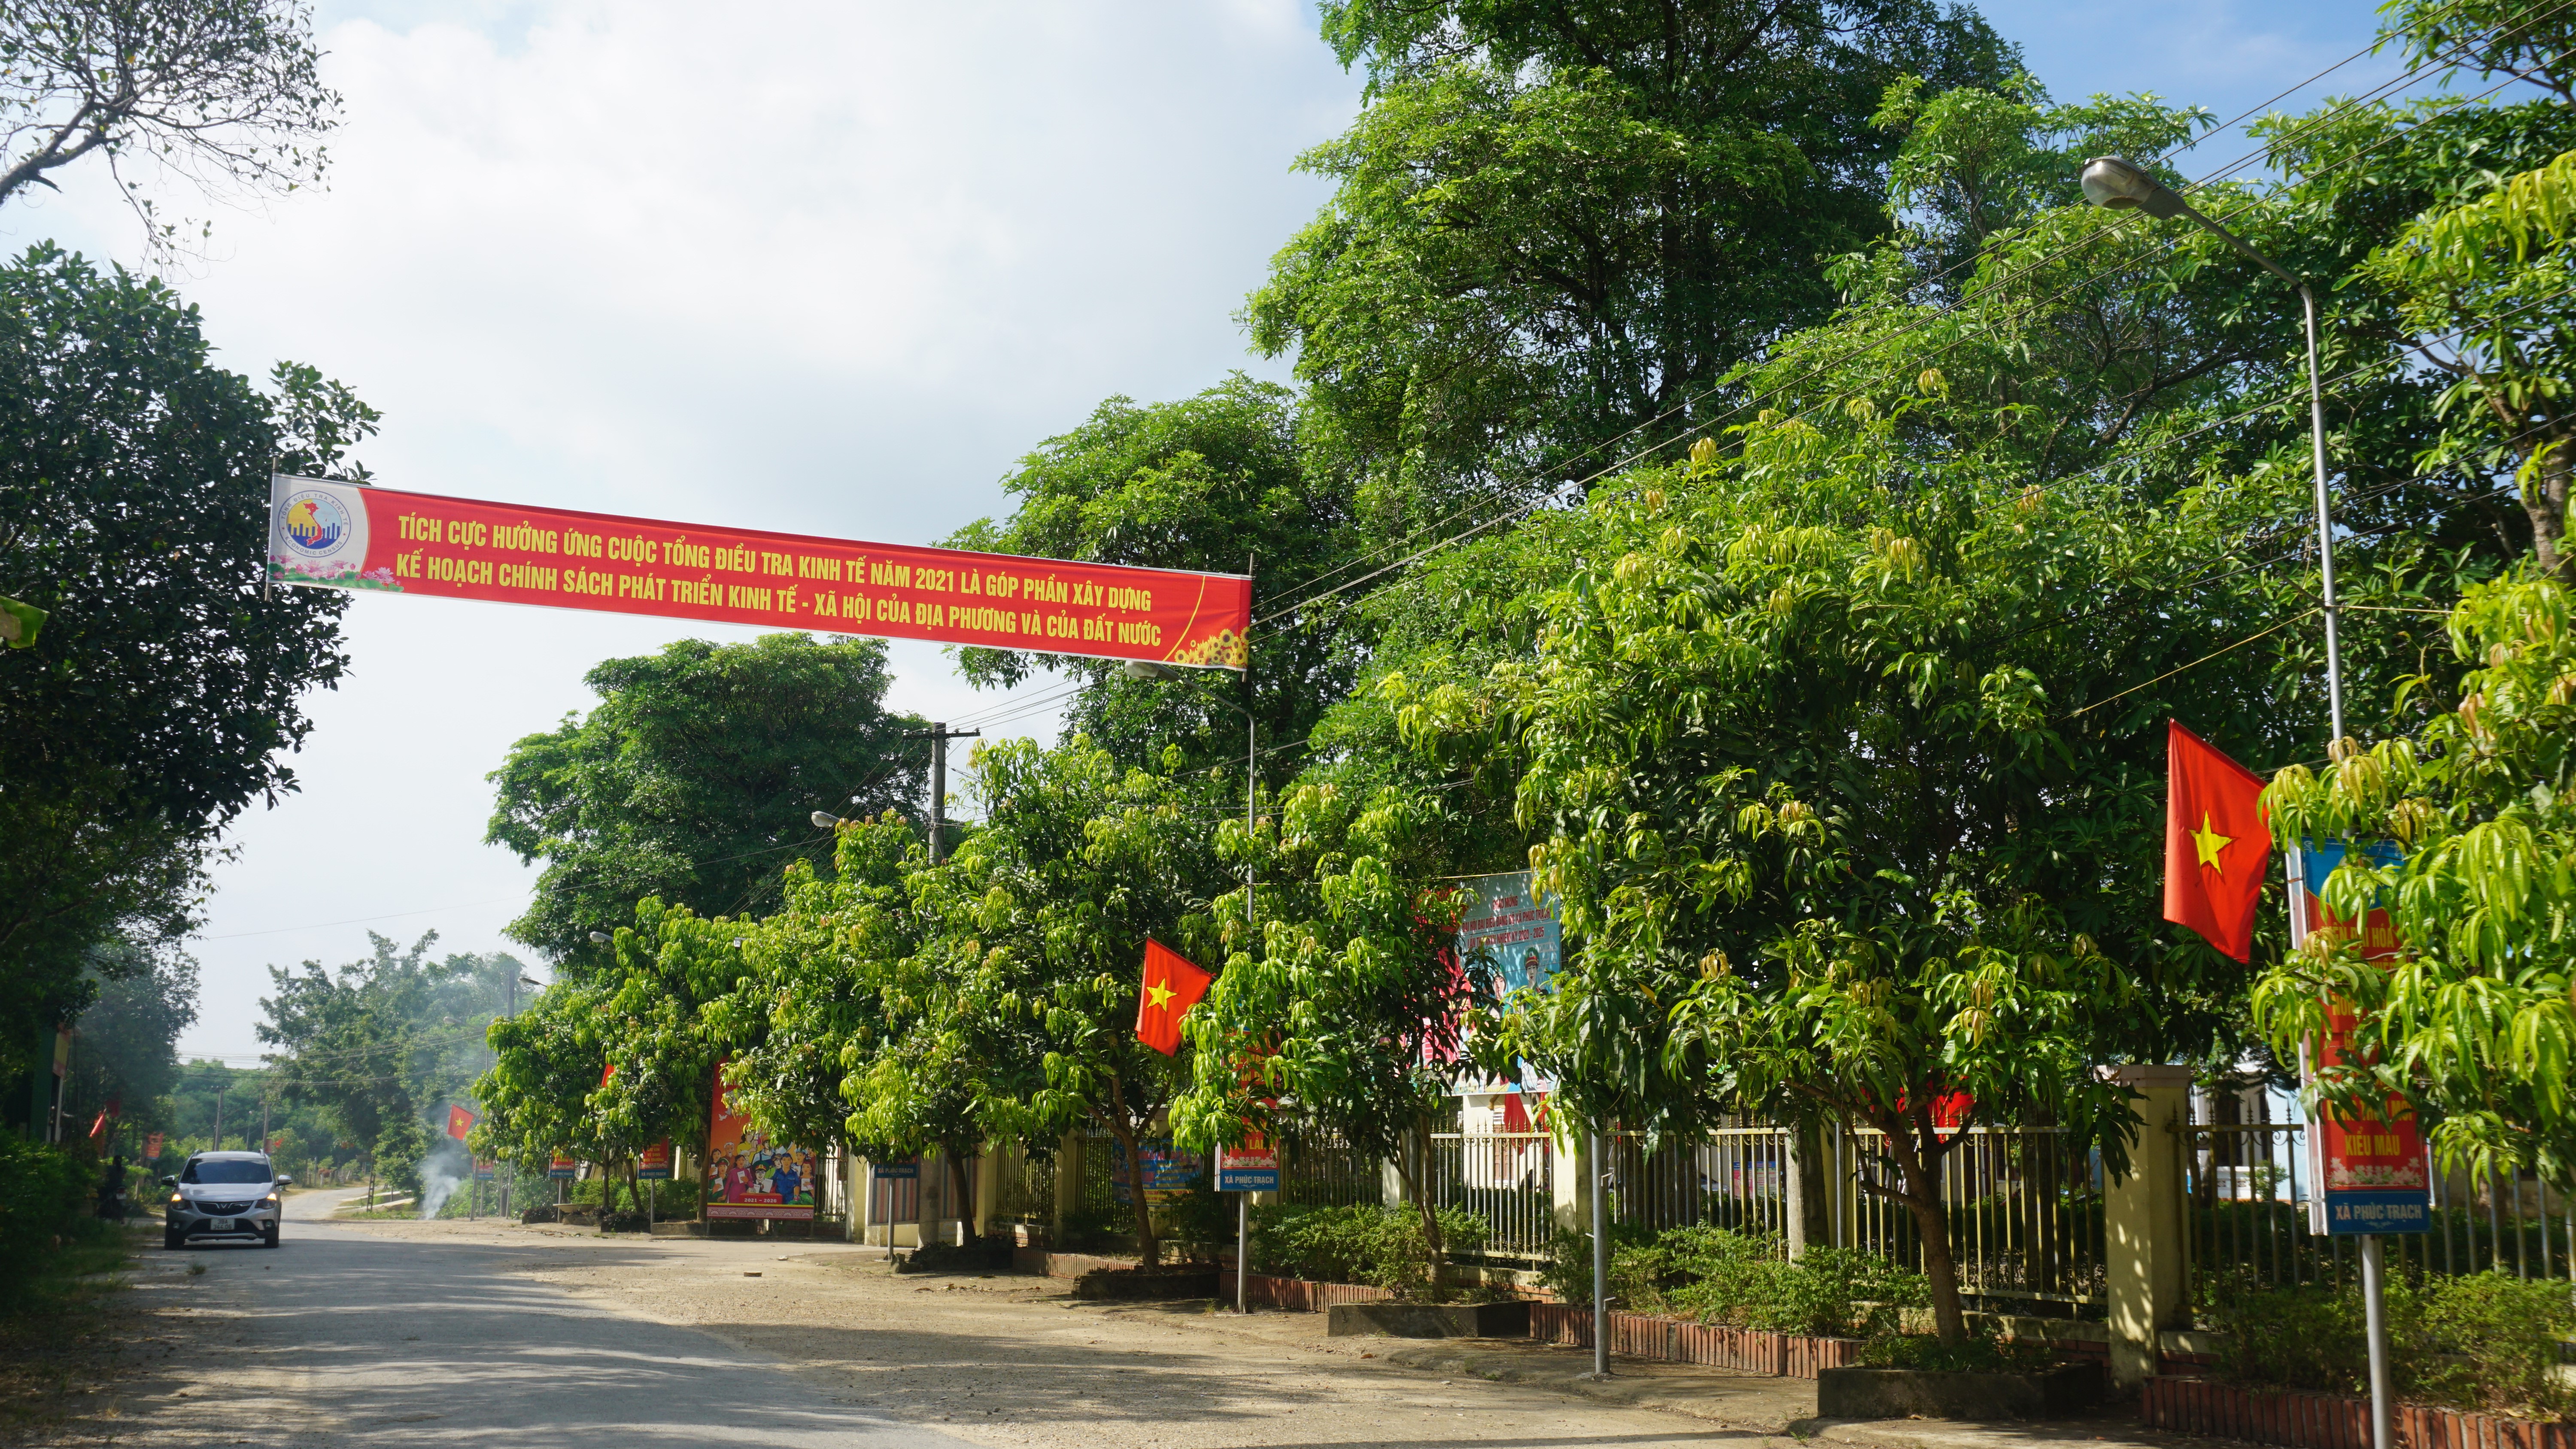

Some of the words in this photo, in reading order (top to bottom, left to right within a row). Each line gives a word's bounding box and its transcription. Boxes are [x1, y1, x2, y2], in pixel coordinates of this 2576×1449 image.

[331, 500, 344, 514] KINH
[285, 536, 316, 555] ECONOMIC
[319, 541, 342, 555] CENSUS
[399, 512, 441, 542] TÍCH
[448, 521, 486, 550] CỰC
[493, 521, 557, 553] HƯỞNG
[564, 528, 601, 558] ỨNG
[608, 535, 656, 567] CUỘC
[663, 536, 709, 568] TỔNG
[715, 543, 755, 573] ĐIỀU
[762, 552, 793, 576] TRA
[799, 556, 840, 581] KINH
[846, 555, 866, 583] TẾ
[871, 560, 910, 588] NĂM
[915, 568, 953, 592] 2021
[961, 569, 981, 594] LÀ
[986, 572, 1018, 597] GÓP
[1024, 574, 1067, 603] PHẦN
[1072, 580, 1103, 606] XÂY
[1109, 587, 1151, 613] DỰNG
[397, 549, 423, 578] KẾ
[428, 557, 492, 587] HOẠCH
[499, 561, 557, 590] CHÍNH
[563, 567, 613, 596] SÁCH
[619, 573, 666, 600] PHÁT
[671, 574, 723, 606] TRIỂN
[729, 585, 771, 610] KINH
[777, 585, 797, 612] TẾ
[814, 591, 837, 616] XÃ
[843, 593, 871, 624] HỘI
[877, 594, 910, 623] CỦA
[916, 603, 943, 630] ĐỊA
[949, 606, 1016, 633] PHƯƠNG
[1021, 610, 1041, 635] VÀ
[1047, 610, 1078, 639] CỦA
[1084, 613, 1113, 642] ĐẤT
[1119, 621, 1160, 646] NƯỚC
[1516, 911, 1522, 922] XÃ
[1523, 909, 1534, 922] PHÚC
[1519, 929, 1529, 941] 2020
[1533, 927, 1544, 938] 2025
[2345, 1126, 2372, 1155] KIỂU
[1225, 1175, 1233, 1183] XÃ
[1254, 1176, 1274, 1185] TRẠCH
[2335, 1203, 2351, 1220] XÃ
[2386, 1204, 2422, 1222] TRẠCH
